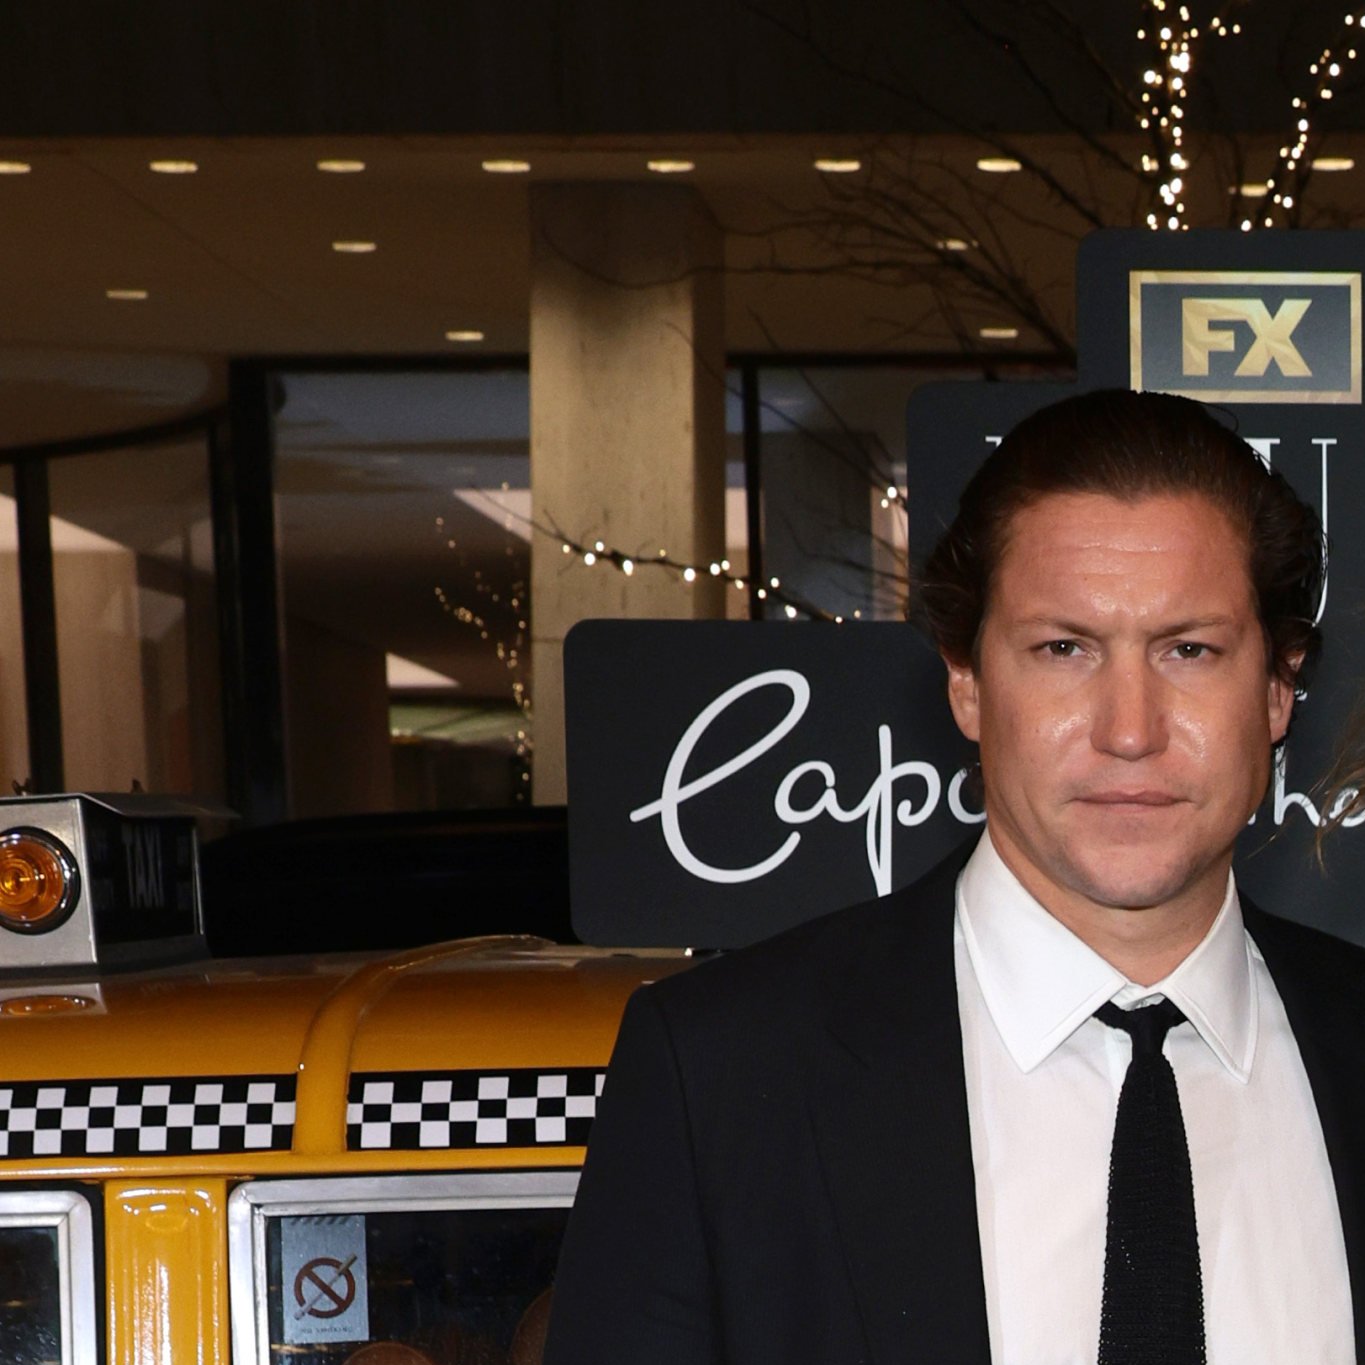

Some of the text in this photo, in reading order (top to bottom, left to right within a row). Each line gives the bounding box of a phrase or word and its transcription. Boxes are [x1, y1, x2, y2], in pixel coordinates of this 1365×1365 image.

[1181, 298, 1313, 377] FX
[629, 668, 988, 898] Capo
[121, 822, 165, 910] TAXI
